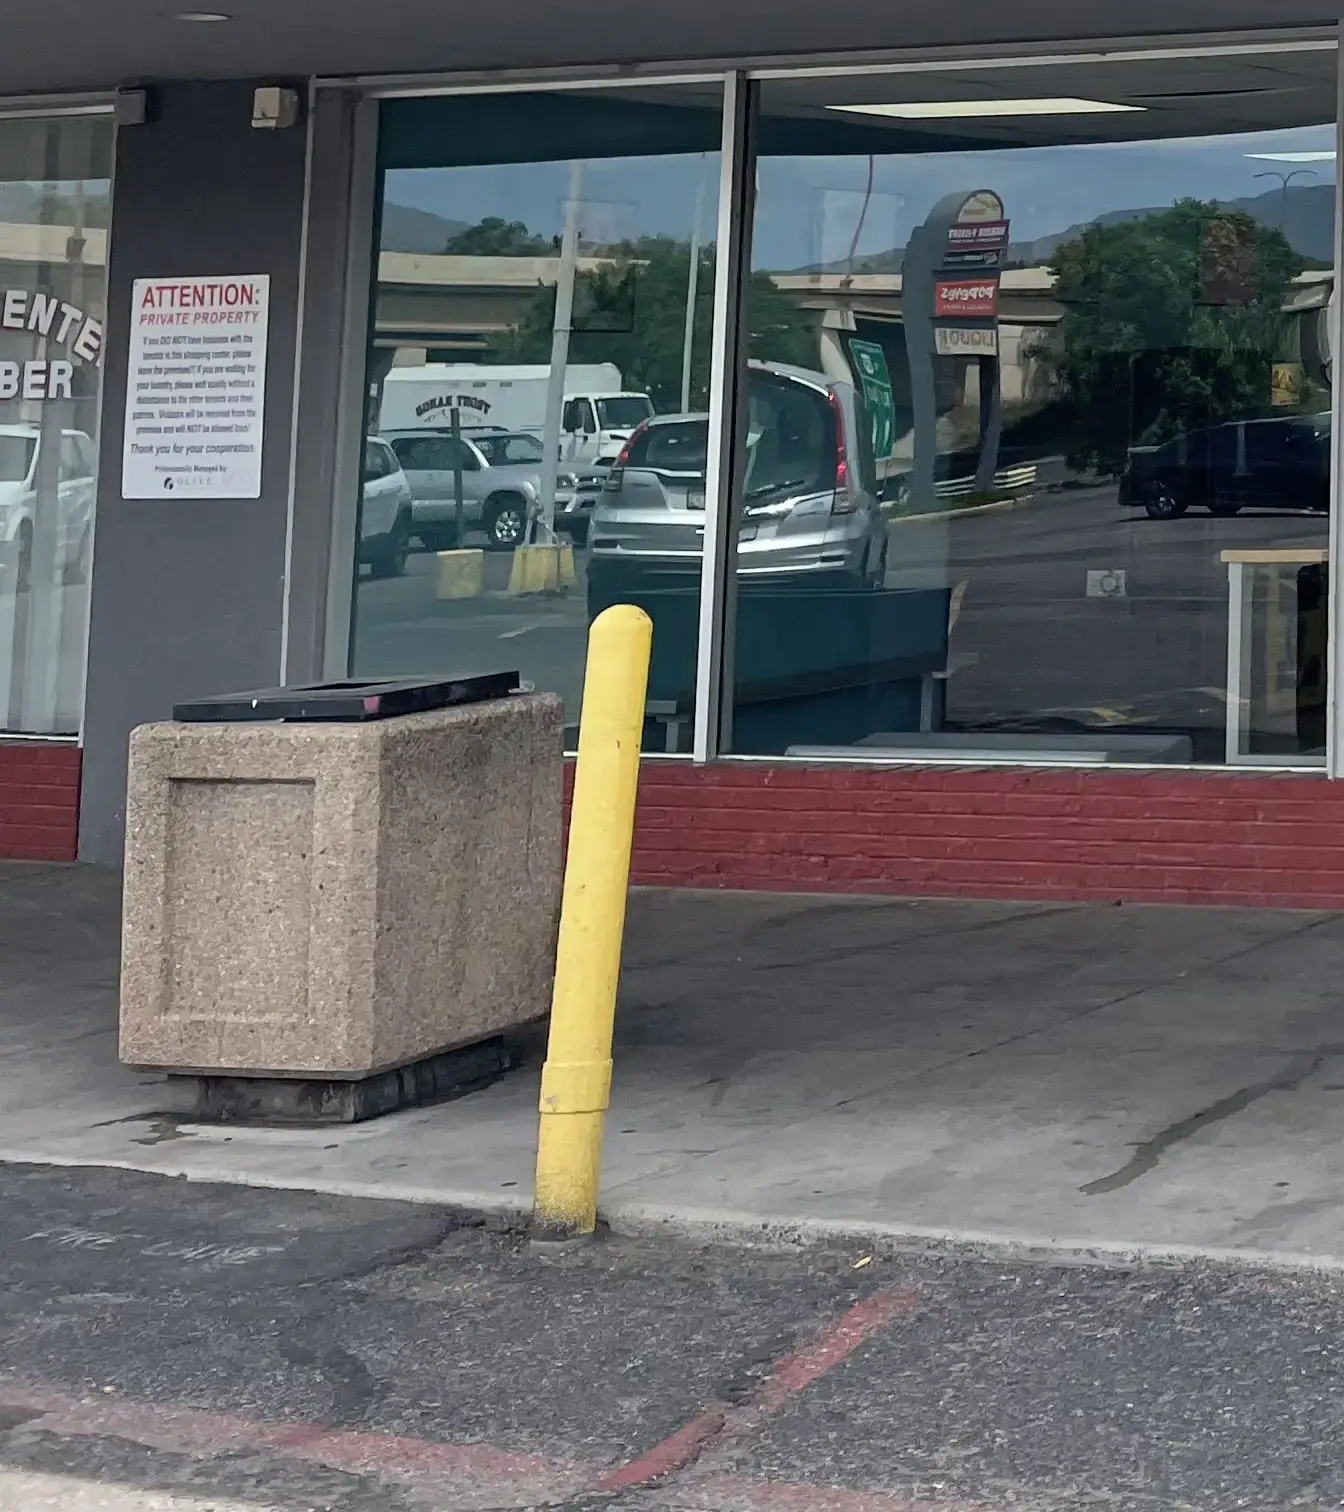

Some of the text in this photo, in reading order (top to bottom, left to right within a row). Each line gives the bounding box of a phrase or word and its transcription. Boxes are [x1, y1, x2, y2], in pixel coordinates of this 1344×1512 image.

[142, 284, 260, 308] ATTENTION:
[2, 290, 106, 368] ENTE
[140, 311, 260, 325] PRIVATE PROPERTY
[0, 360, 74, 399] BER
